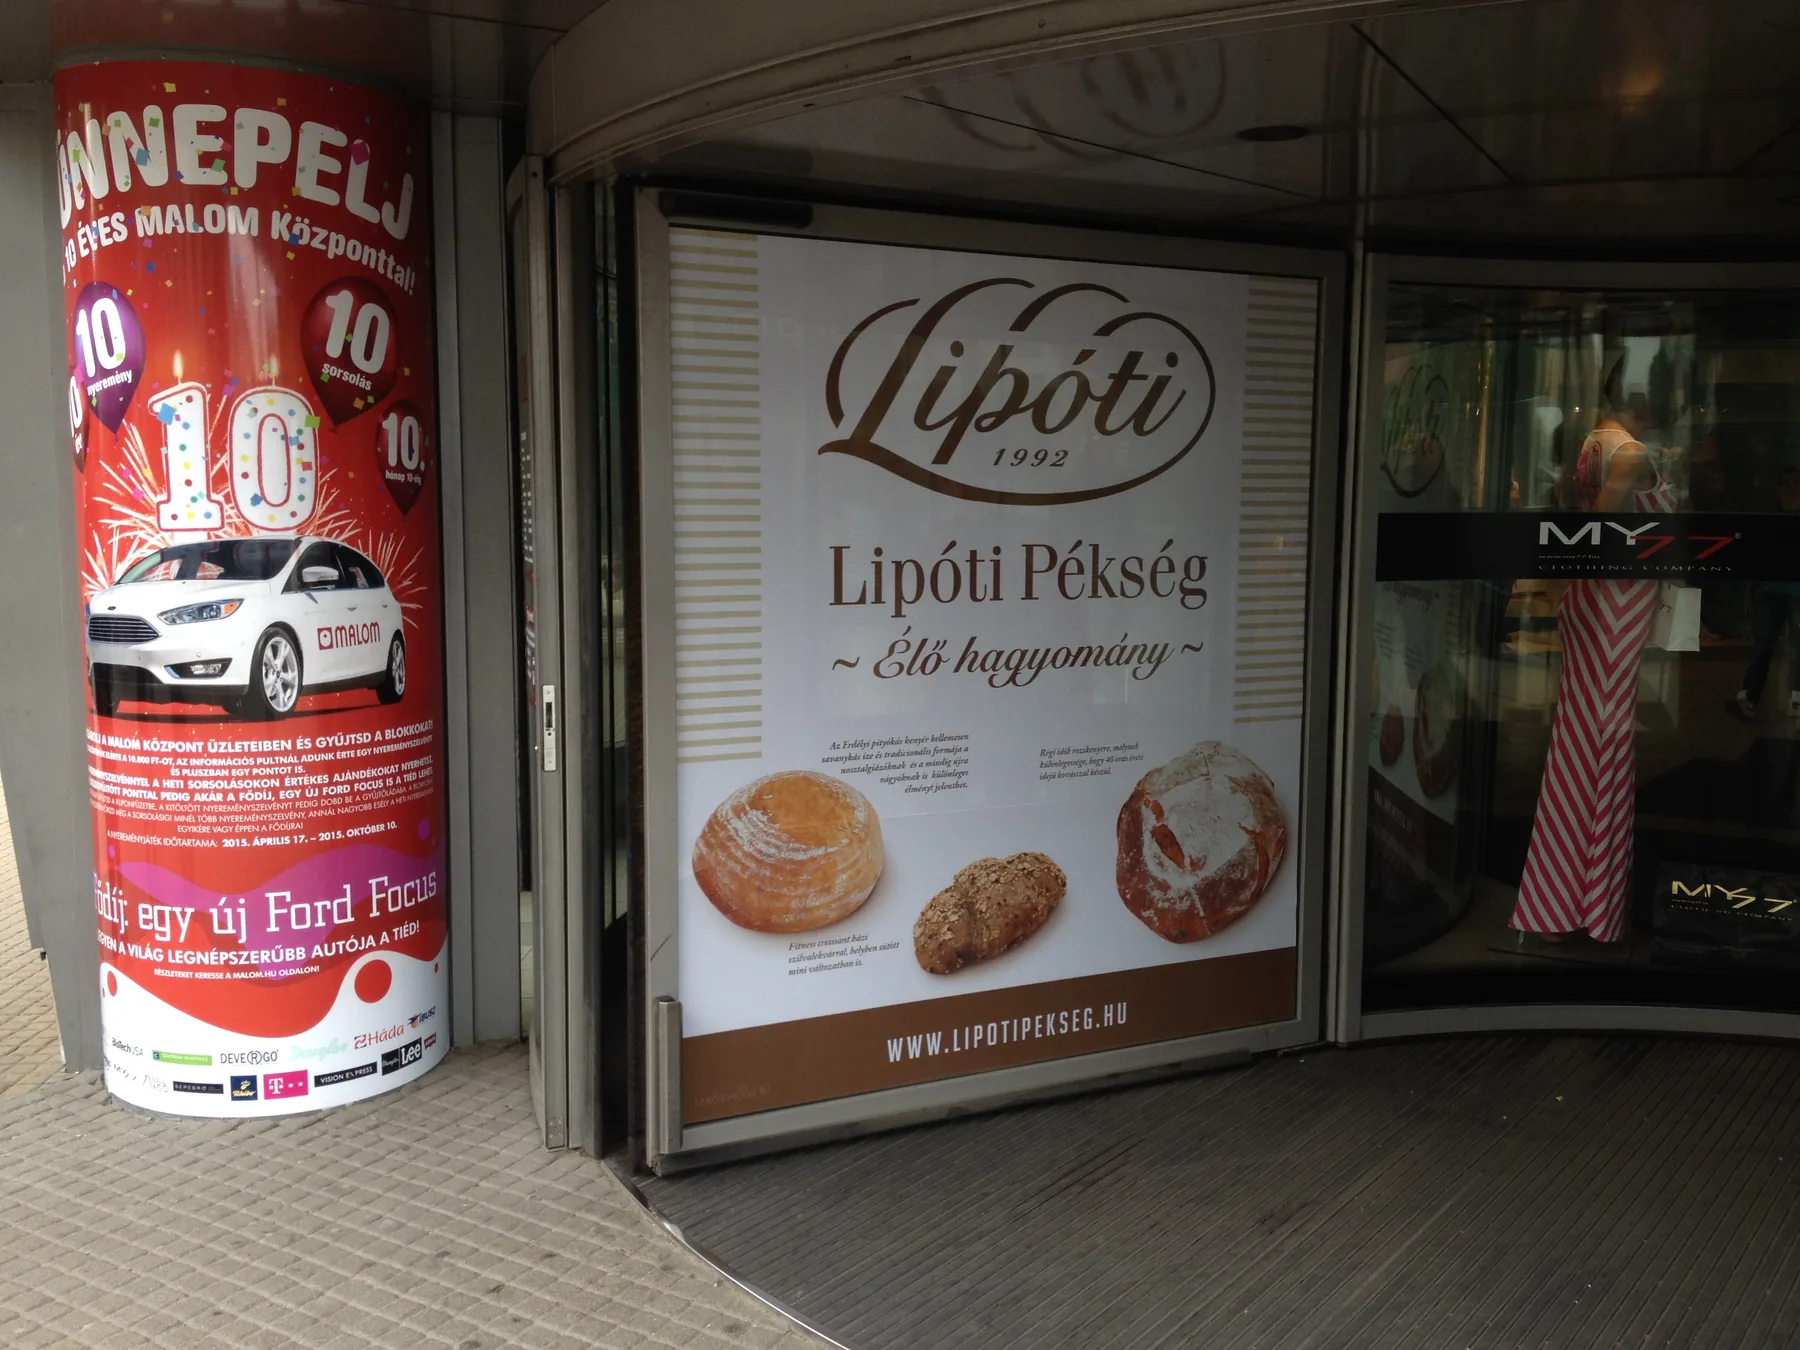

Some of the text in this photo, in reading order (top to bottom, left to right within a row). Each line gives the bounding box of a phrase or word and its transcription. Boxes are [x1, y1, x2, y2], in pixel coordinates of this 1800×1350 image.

[77, 212, 128, 258] ÉVES
[135, 203, 259, 238] MALOM
[271, 210, 415, 296] Központtal!
[75, 297, 126, 378] 10
[325, 289, 390, 374] 10
[322, 361, 372, 391] sorsolás
[818, 277, 1187, 468] Lipóti
[87, 370, 132, 397] nyeremény
[992, 447, 1069, 468] 1992
[829, 538, 1208, 618] Lipóti Pékség
[334, 621, 380, 647] MALOM
[873, 625, 1174, 688] Élő hagyomány
[108, 736, 141, 750] MALOM
[143, 737, 204, 753] KÖZPONT
[207, 739, 292, 753] ÜZLETEIBEN
[296, 735, 312, 750] ÉS
[315, 732, 371, 748] GYŰJTSD
[374, 731, 382, 741] A
[829, 733, 969, 751] Az Erdélyi pityókás kenyér kellemesen
[1040, 748, 1056, 759] Régi
[1112, 742, 1139, 753] melynek
[128, 755, 150, 764] 10.000
[176, 758, 188, 766] AZ
[189, 756, 254, 766] INFORMÁCIÓS
[257, 754, 299, 765] PULTNÁL
[301, 752, 335, 763] ADUNK
[336, 749, 355, 759] ÉRTE
[357, 748, 372, 757] EGY
[821, 747, 963, 764] savanykás és tradicionális formája
[840, 763, 906, 775] nosztalgiázóknak
[925, 758, 952, 768] mindig
[953, 757, 969, 766] újra
[1089, 757, 1104, 766] hogy
[152, 764, 399, 789] A HETI SORSOLÁSOKON ÉRTÉKES AJÁNDÉKOKAT
[170, 765, 306, 777] ÉS PLUSZBAN EGY PONTOT IS.
[931, 769, 969, 779] különleges
[122, 787, 158, 800] PONTTAL
[160, 791, 190, 801] PEDIG
[193, 790, 223, 801] AKÁR
[227, 792, 235, 801] A
[239, 789, 275, 801] FŐDÍJ,
[279, 789, 301, 799] EGY
[305, 786, 319, 797] ÚJ
[322, 784, 350, 796] FORD
[354, 779, 383, 792] FOCUS
[386, 777, 393, 786] IS
[395, 776, 401, 785] A
[403, 771, 417, 783] TIÉD
[905, 784, 934, 794] élményt
[165, 803, 201, 812] KITÖLTÖTT
[203, 801, 292, 812] NYEREMÉNYSZELVÉNYT
[295, 800, 318, 808] PEDIG
[320, 798, 343, 806] DOBD
[174, 814, 196, 823] MINÉL
[197, 814, 217, 823] TÖBB
[308, 808, 336, 818] ANNÁL
[337, 803, 372, 814] NAGYOBB
[373, 799, 389, 810] ESÉLY
[163, 836, 218, 848] IDŐTARTAMA:
[222, 838, 250, 848] 2015.
[252, 836, 290, 847] ÁPRILIS
[293, 834, 308, 844] 17.
[318, 831, 345, 841] 2015.
[346, 823, 385, 837] OKTÓBER
[387, 821, 397, 830] 10.
[177, 824, 211, 833] EGYIKÉRE
[212, 825, 233, 833] VAGY
[235, 823, 259, 833] ÉPPEN
[261, 824, 267, 832] A
[138, 903, 195, 943] egy
[209, 895, 247, 944] új
[264, 883, 355, 932] Ford
[368, 871, 437, 918] Focus
[118, 941, 126, 956] A
[127, 943, 164, 962] VILÁG
[167, 945, 306, 966] LEGNÉPSZERŰBB
[311, 934, 376, 959] AUTÓJA
[380, 931, 390, 945] A
[392, 920, 420, 941] TIÉD!
[789, 934, 868, 951] Fitness croissant házi
[788, 948, 848, 964] szilvalekvárral,
[849, 944, 877, 956] helyben
[194, 971, 224, 980] KERESSE
[278, 965, 320, 977] OLDALON!
[788, 960, 854, 976] mini változatban
[368, 1024, 405, 1045] Háda
[887, 1002, 1128, 1063] WWW.LIPOTIPEKSEG.HU
[401, 1042, 421, 1065] Lee
[320, 1074, 344, 1083] VISION
